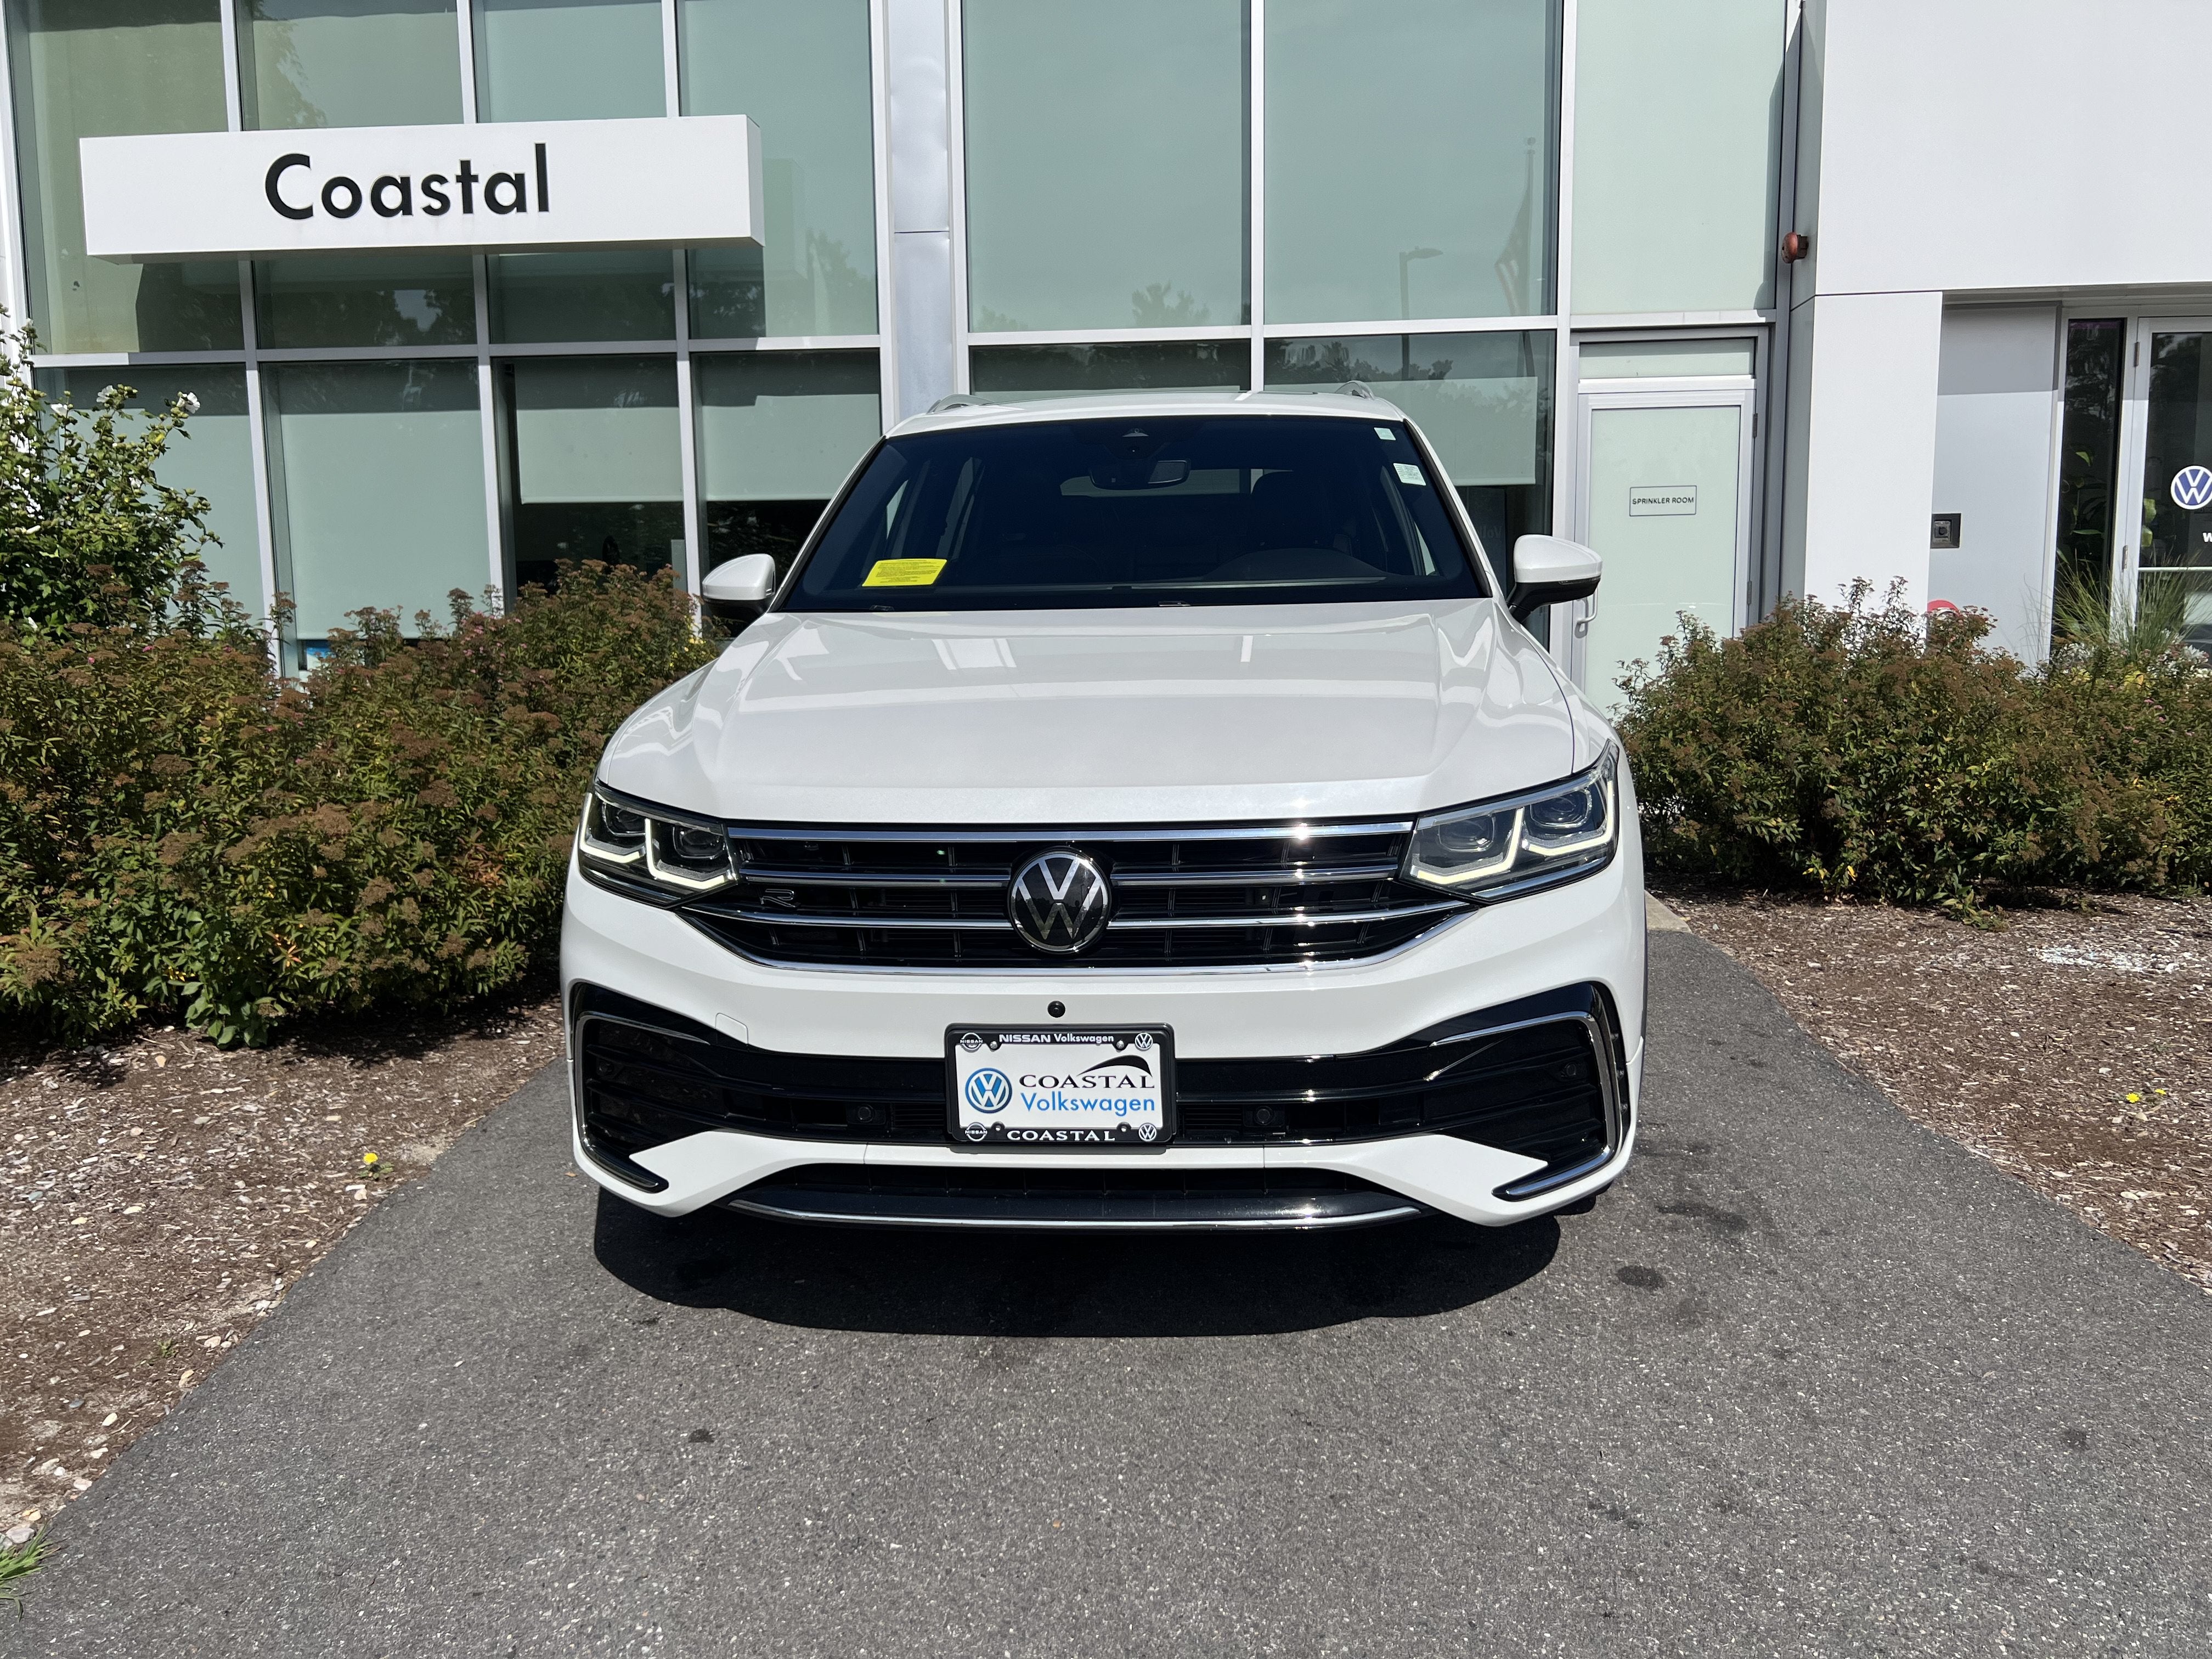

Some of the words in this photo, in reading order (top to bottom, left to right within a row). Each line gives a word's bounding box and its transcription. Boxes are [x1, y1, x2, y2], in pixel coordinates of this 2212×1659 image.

[265, 142, 550, 219] Coastal
[999, 1034, 1051, 1042] NISSAN
[1053, 1033, 1114, 1043] Volkswagen
[1019, 1074, 1155, 1088] COASTAL
[1020, 1091, 1155, 1116] Volkswagen
[1007, 1130, 1115, 1141] COASTAL
